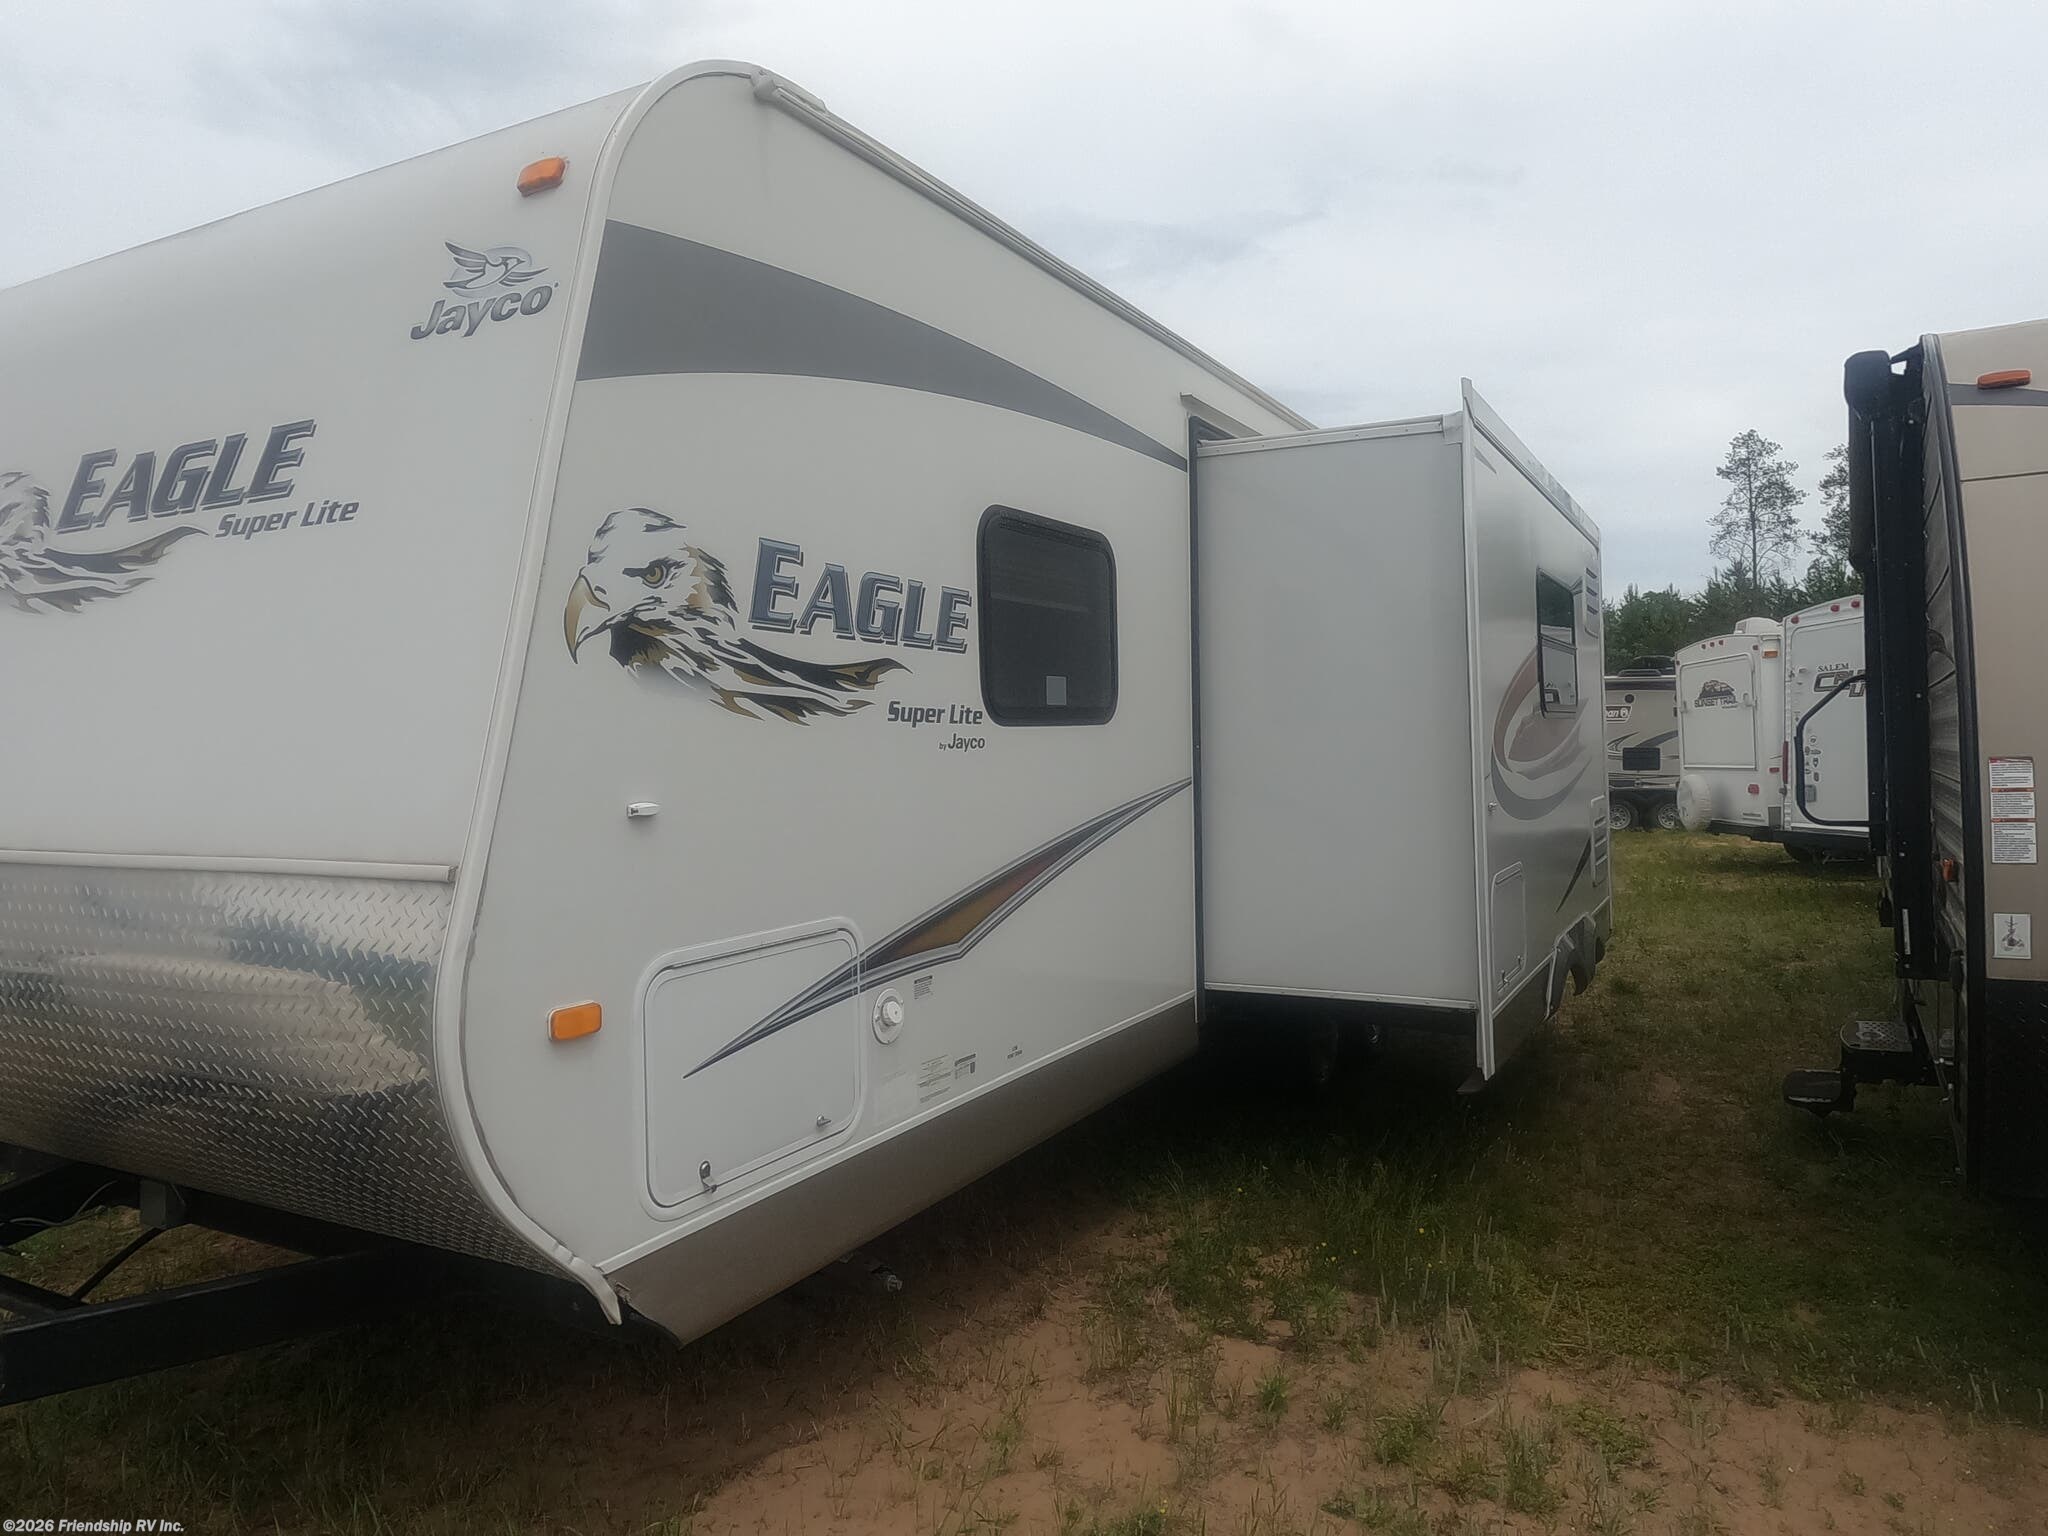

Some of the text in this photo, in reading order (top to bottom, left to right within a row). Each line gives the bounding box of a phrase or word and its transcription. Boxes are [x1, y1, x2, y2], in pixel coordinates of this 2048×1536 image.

[410, 285, 553, 340] Jayco
[56, 419, 317, 535] EAGLE
[215, 500, 359, 540] Super Lite
[748, 537, 972, 654] EAGLE
[1818, 663, 1849, 672] SALEM
[887, 700, 983, 728] Super Lite
[939, 733, 985, 752] by Jayco
